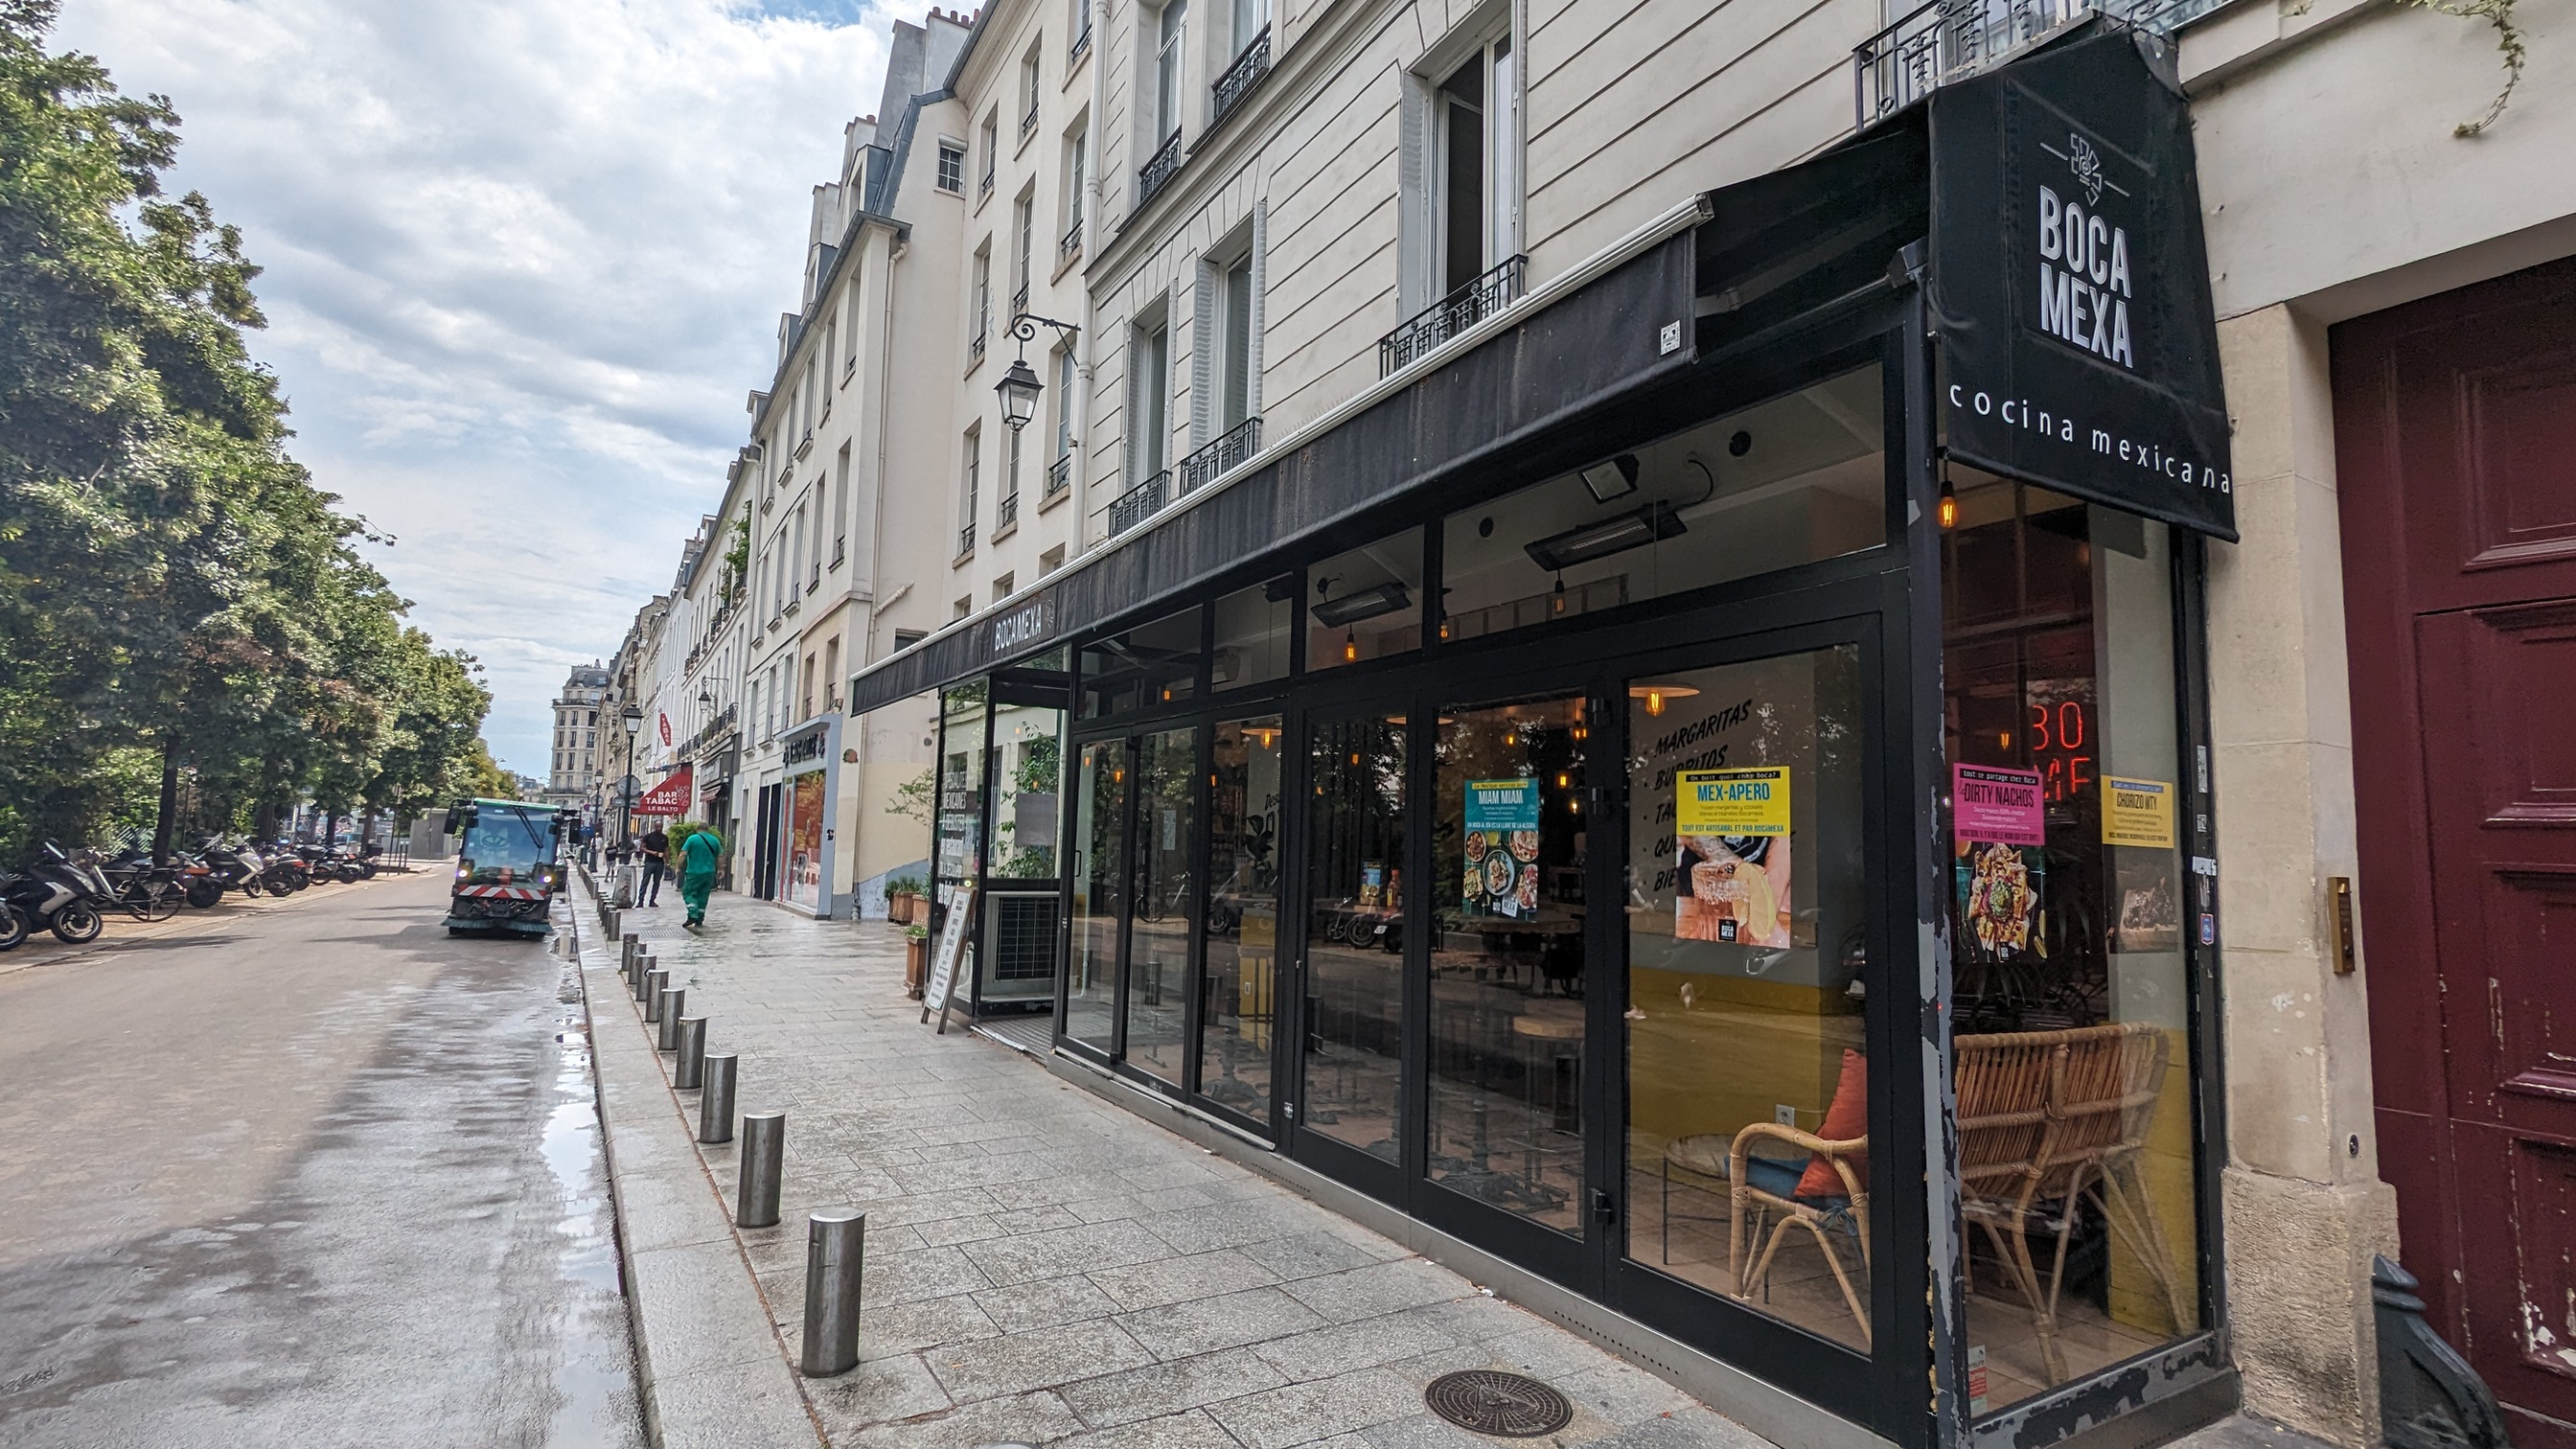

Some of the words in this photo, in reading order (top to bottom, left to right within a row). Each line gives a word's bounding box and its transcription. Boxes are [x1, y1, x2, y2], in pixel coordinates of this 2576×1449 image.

[2040, 185, 2131, 299] BOCA
[2040, 262, 2133, 369] MEXA
[1949, 384, 2074, 443] cocina
[2091, 428, 2230, 494] mexicana
[995, 603, 1042, 652] BOCAMEXA
[661, 718, 670, 743] TABAC
[1654, 699, 1753, 758] MARGARITAS
[1479, 791, 1499, 804] MIAM
[1501, 790, 1524, 804] MIAM
[1697, 782, 1770, 802] MEX-APERO
[1964, 783, 1993, 804] DIRTY
[1995, 786, 2035, 808] NACHOS
[2117, 793, 2144, 809] CHORIZO
